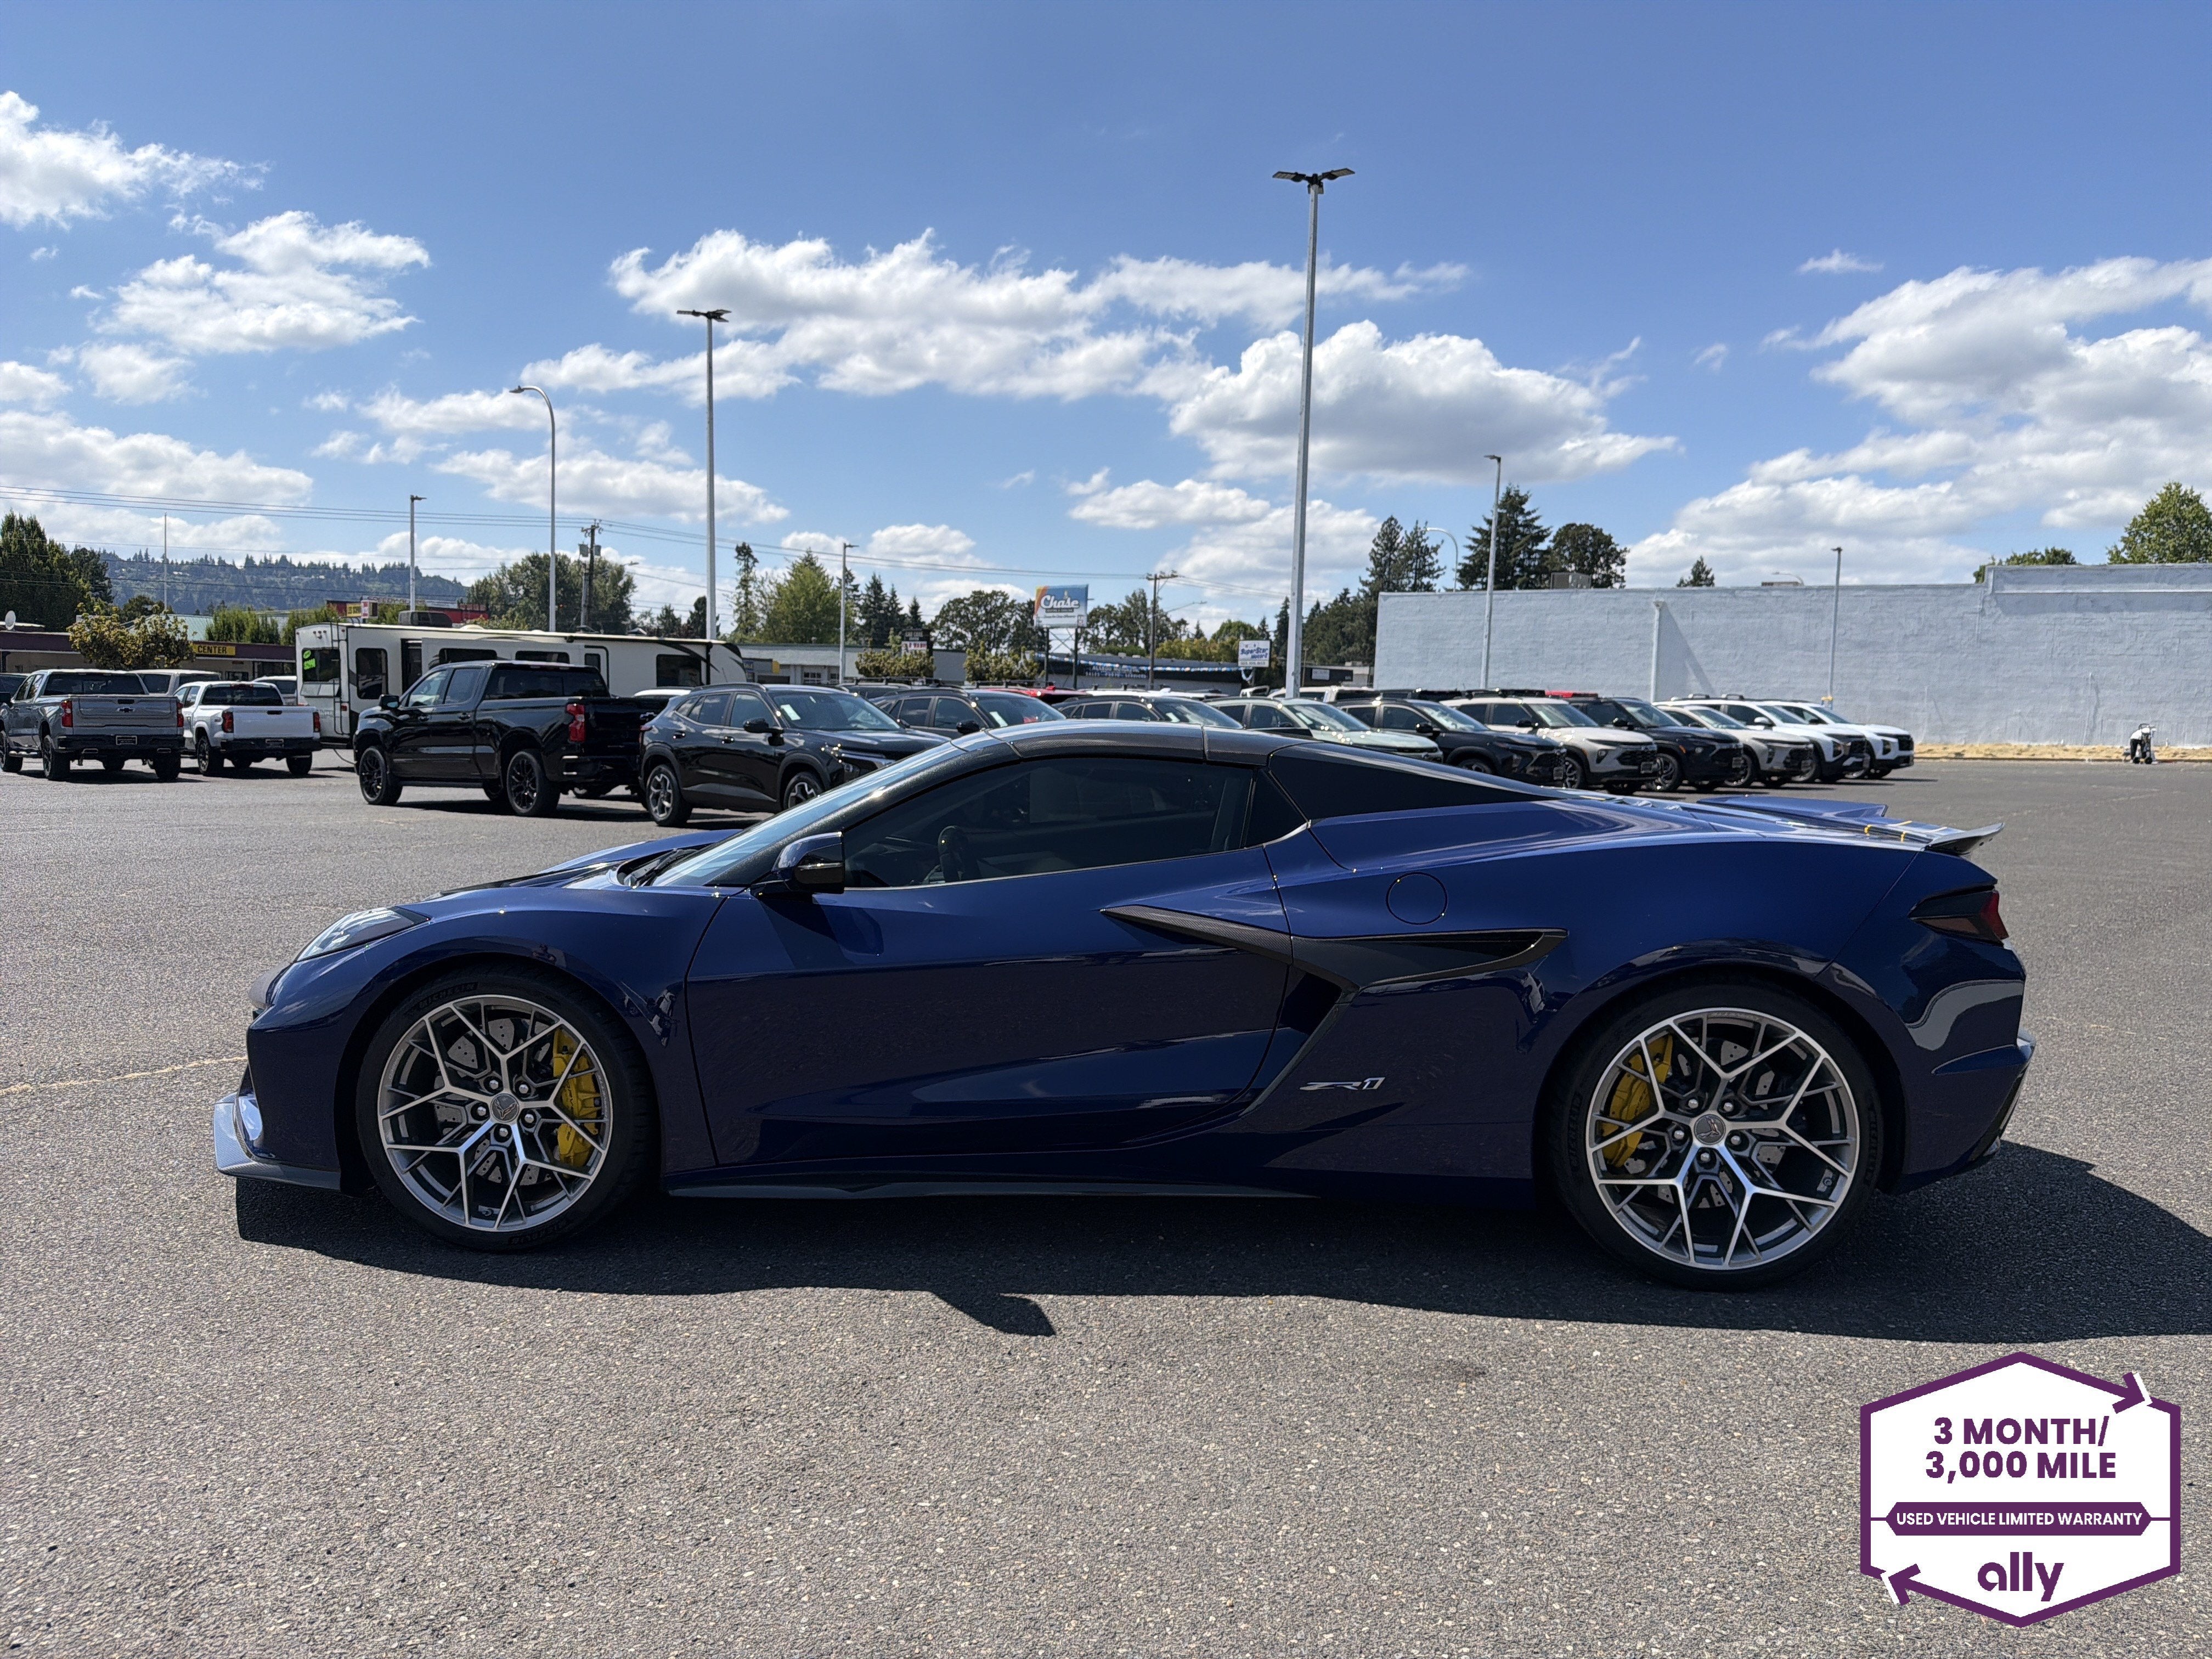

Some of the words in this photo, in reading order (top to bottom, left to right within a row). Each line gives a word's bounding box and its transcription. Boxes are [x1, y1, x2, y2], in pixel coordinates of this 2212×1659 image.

[1041, 595, 1079, 608] Chase
[198, 645, 227, 654] CENTER
[1300, 1077, 1386, 1090] ZR1
